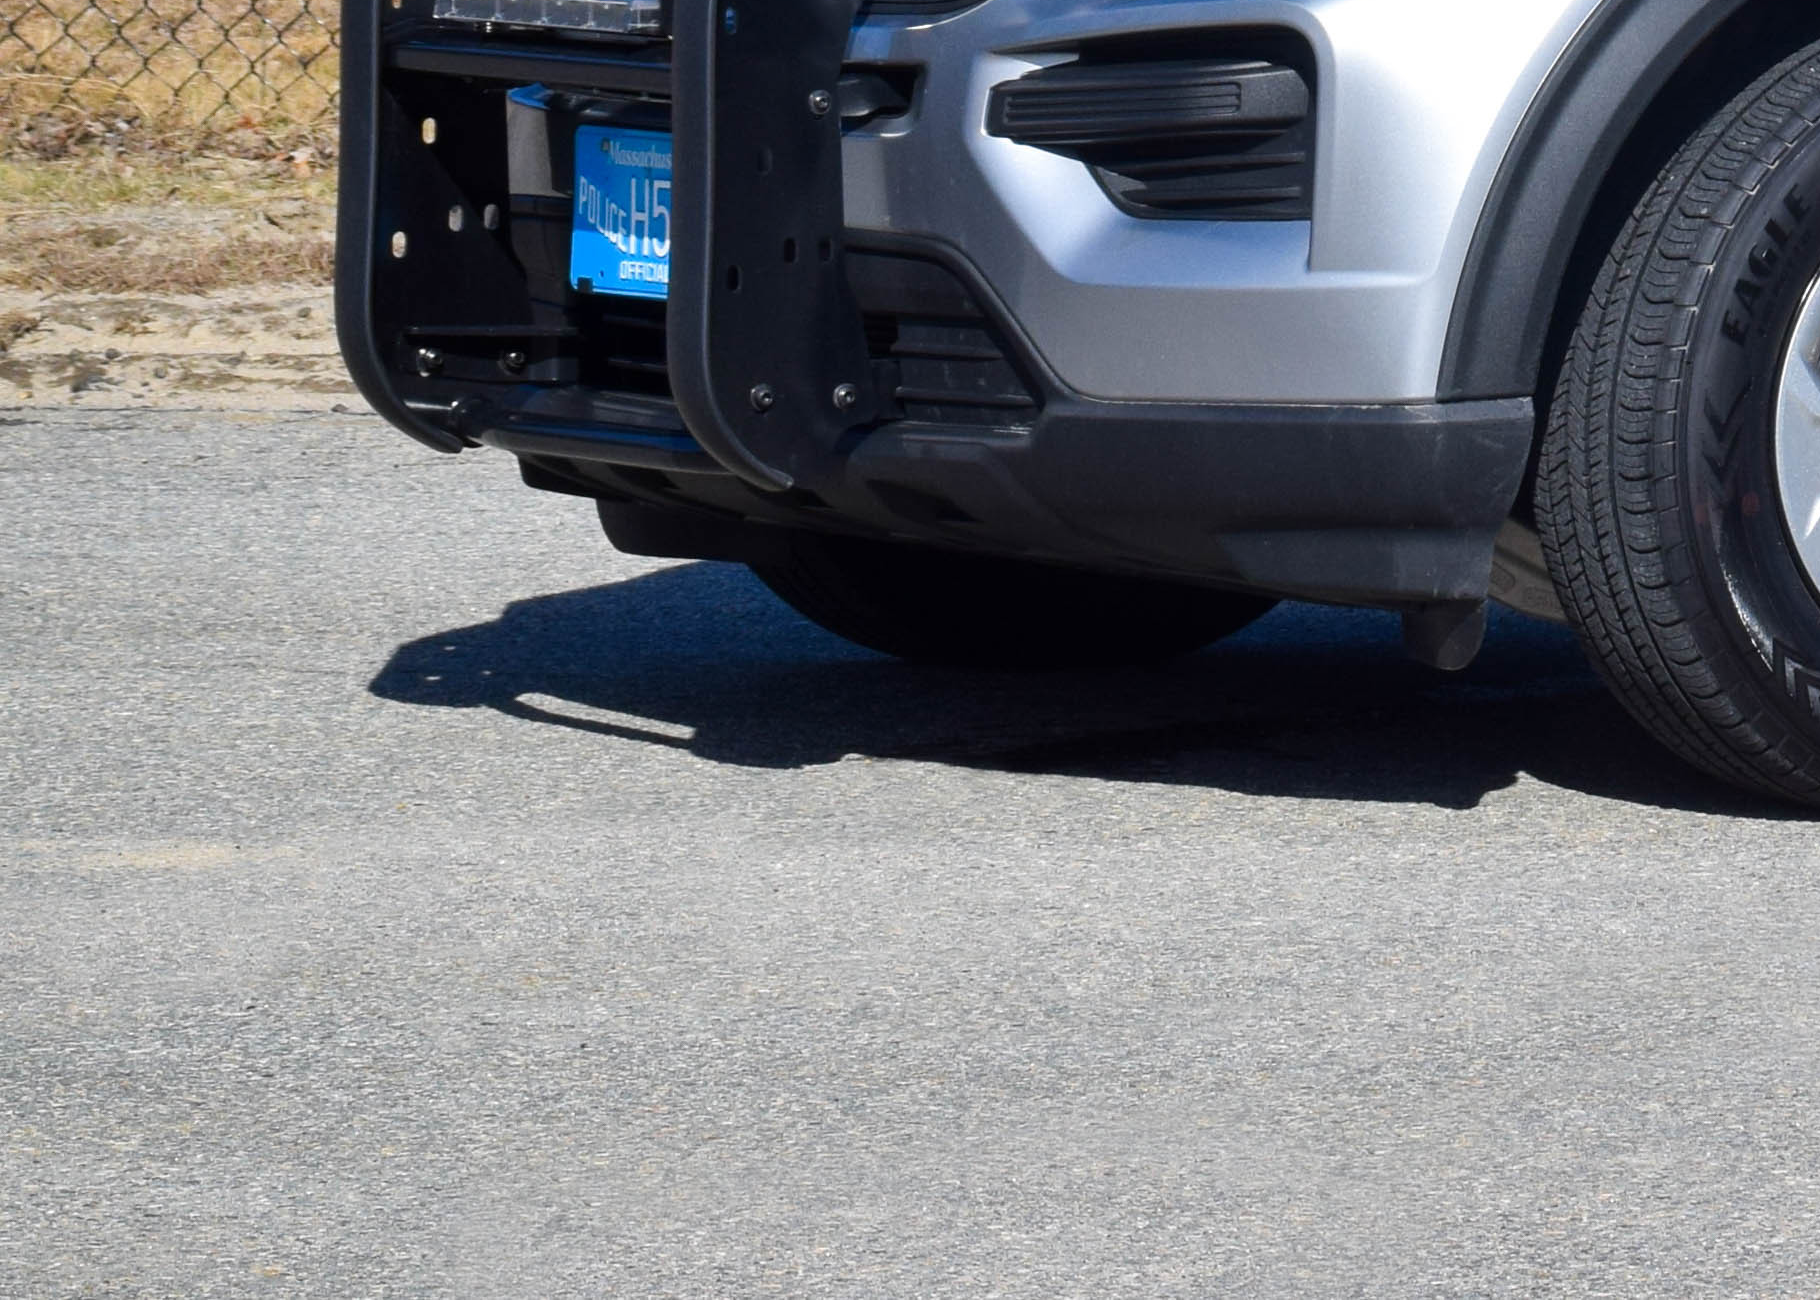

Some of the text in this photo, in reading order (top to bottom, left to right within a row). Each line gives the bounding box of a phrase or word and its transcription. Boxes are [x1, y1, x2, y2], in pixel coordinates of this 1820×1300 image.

[609, 139, 672, 169] Massachus
[579, 175, 671, 257] POLICE H5
[1720, 184, 1812, 347] EAGLE
